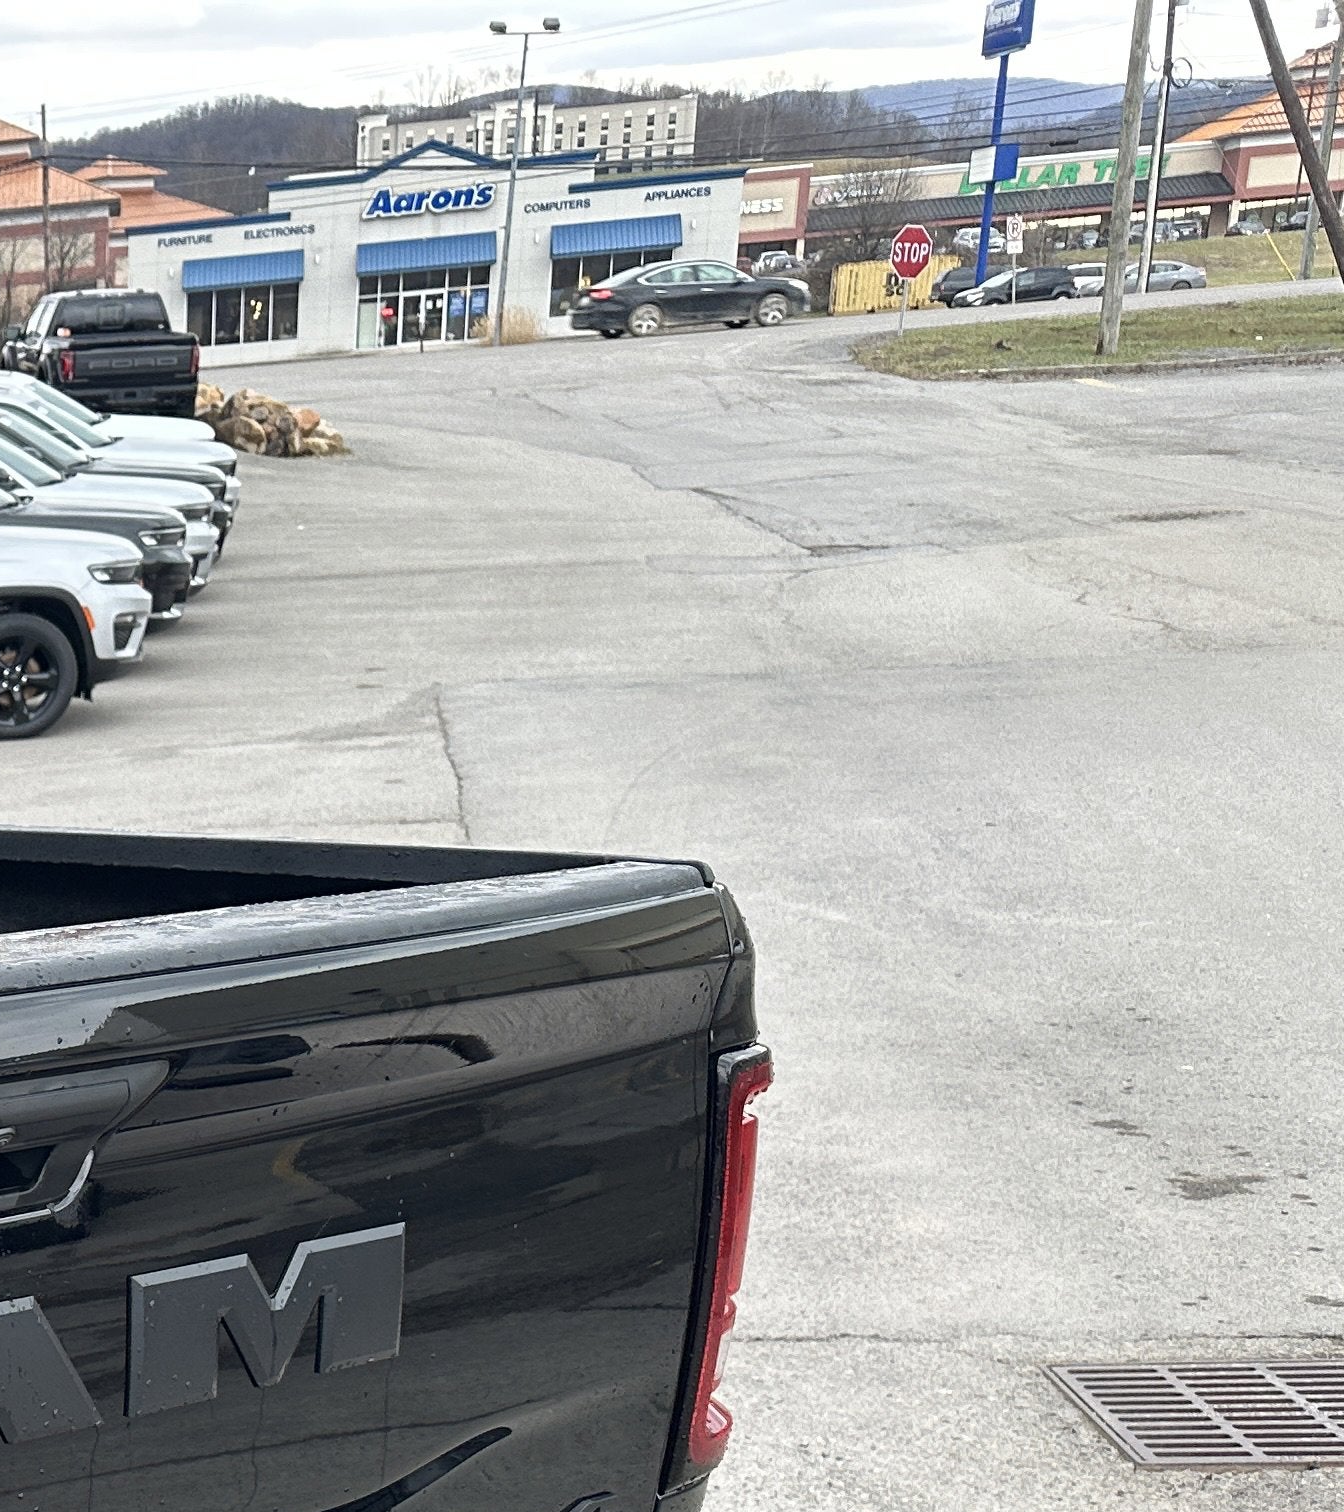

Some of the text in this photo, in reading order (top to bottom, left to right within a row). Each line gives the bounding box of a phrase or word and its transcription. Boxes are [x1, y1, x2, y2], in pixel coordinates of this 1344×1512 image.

[365, 183, 495, 217] Aaron's
[644, 186, 712, 203] APPLIANCES
[524, 198, 591, 214] COMPUTERS
[244, 224, 315, 240] ELECTRONICS
[157, 234, 213, 248] FURNITURE
[893, 242, 929, 264] STOP
